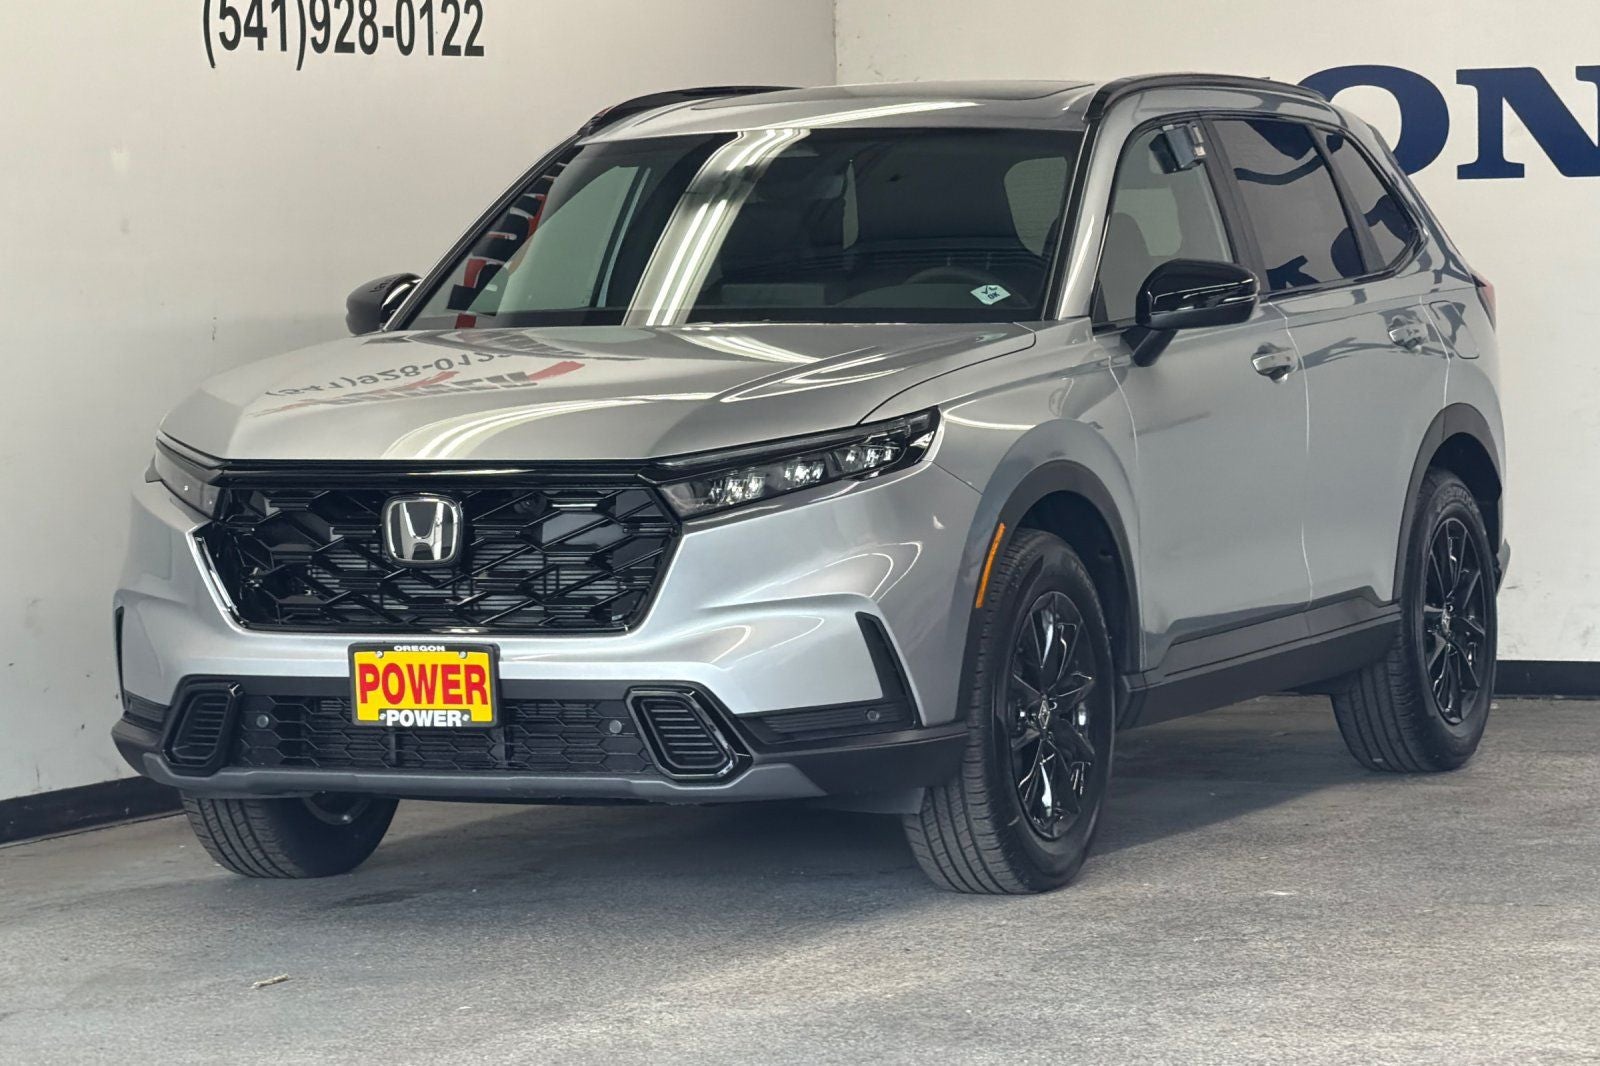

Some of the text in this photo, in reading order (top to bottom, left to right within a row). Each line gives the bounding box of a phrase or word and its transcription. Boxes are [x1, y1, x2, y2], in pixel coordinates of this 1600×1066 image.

[203, 0, 485, 71] (541)928-0122
[358, 662, 489, 705] POWER
[386, 709, 462, 727] POWER
